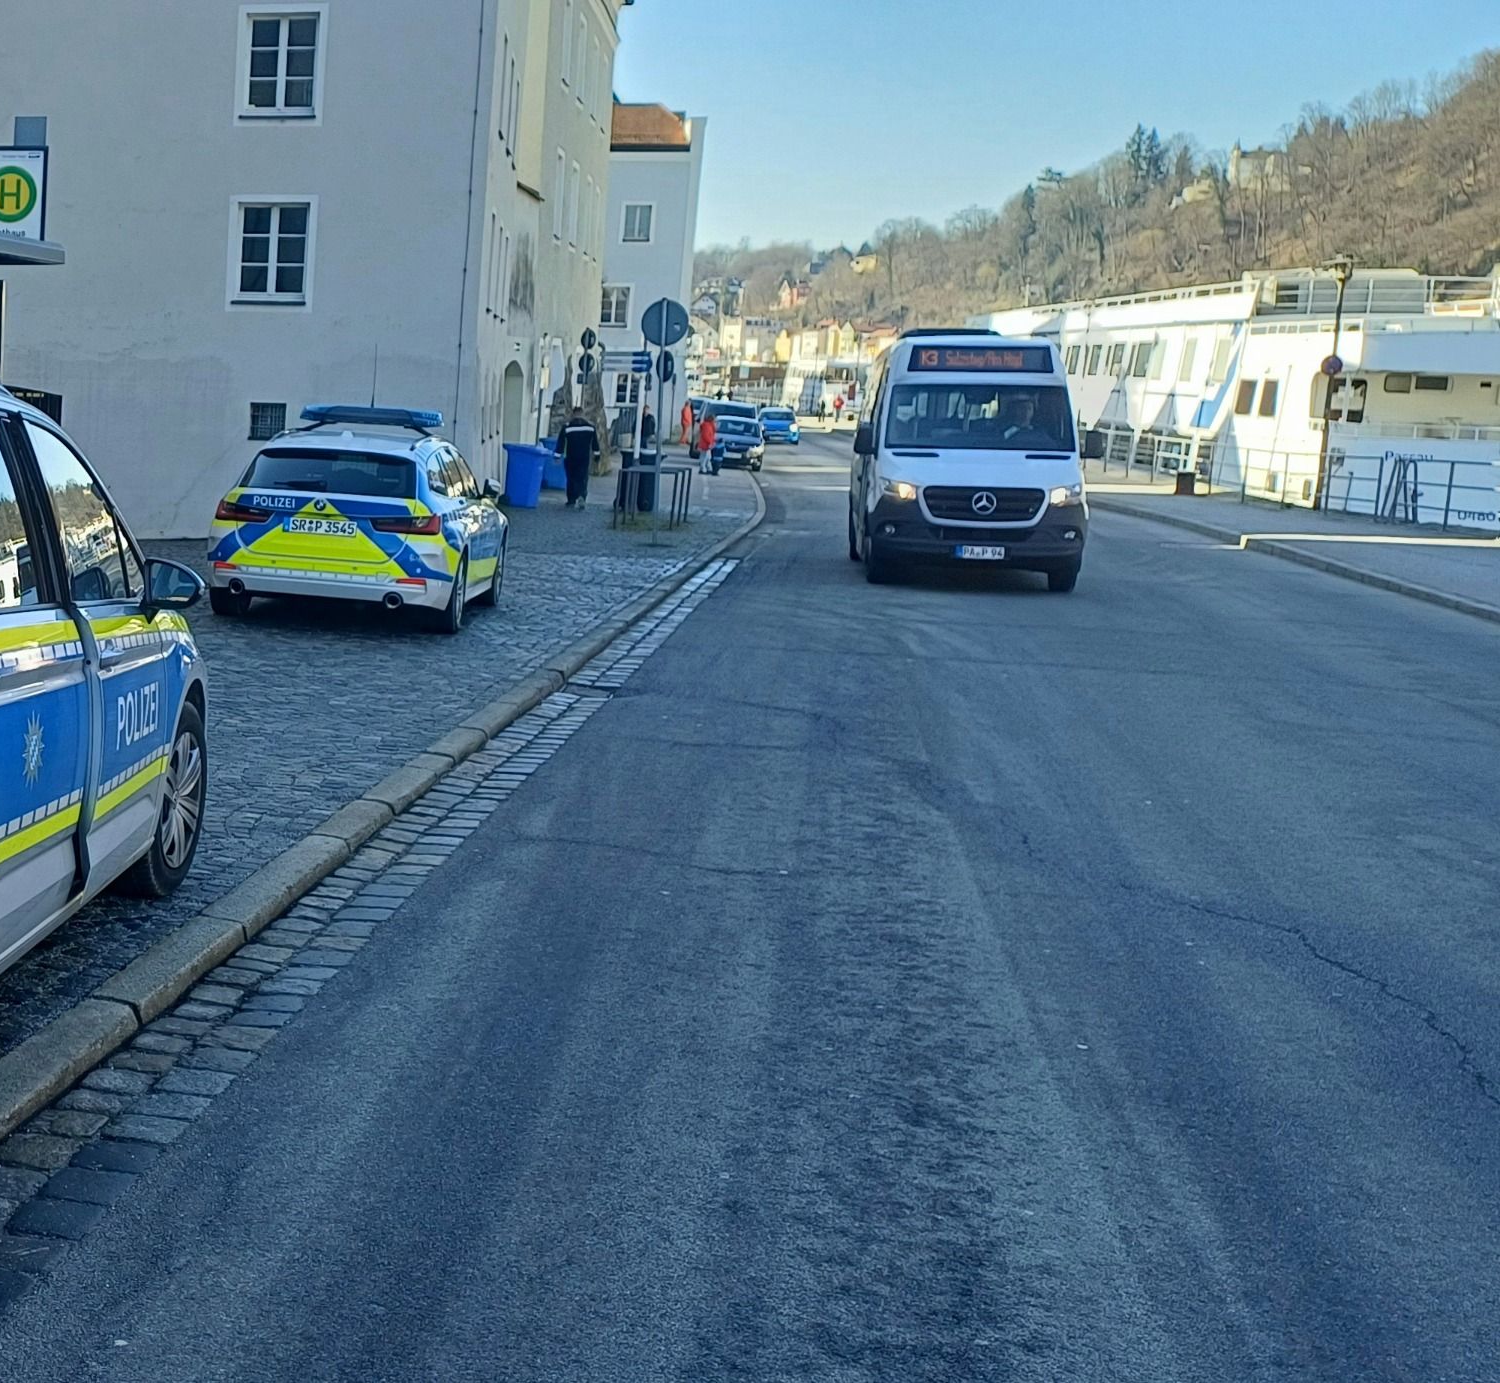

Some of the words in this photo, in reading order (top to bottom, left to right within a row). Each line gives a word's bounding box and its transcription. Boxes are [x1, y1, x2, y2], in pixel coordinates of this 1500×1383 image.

[0, 178, 21, 210] H
[253, 495, 296, 509] POLIZEI
[291, 519, 306, 531] SR
[315, 521, 323, 532] P
[325, 522, 355, 535] 3545
[116, 681, 159, 751] POLIZEI
